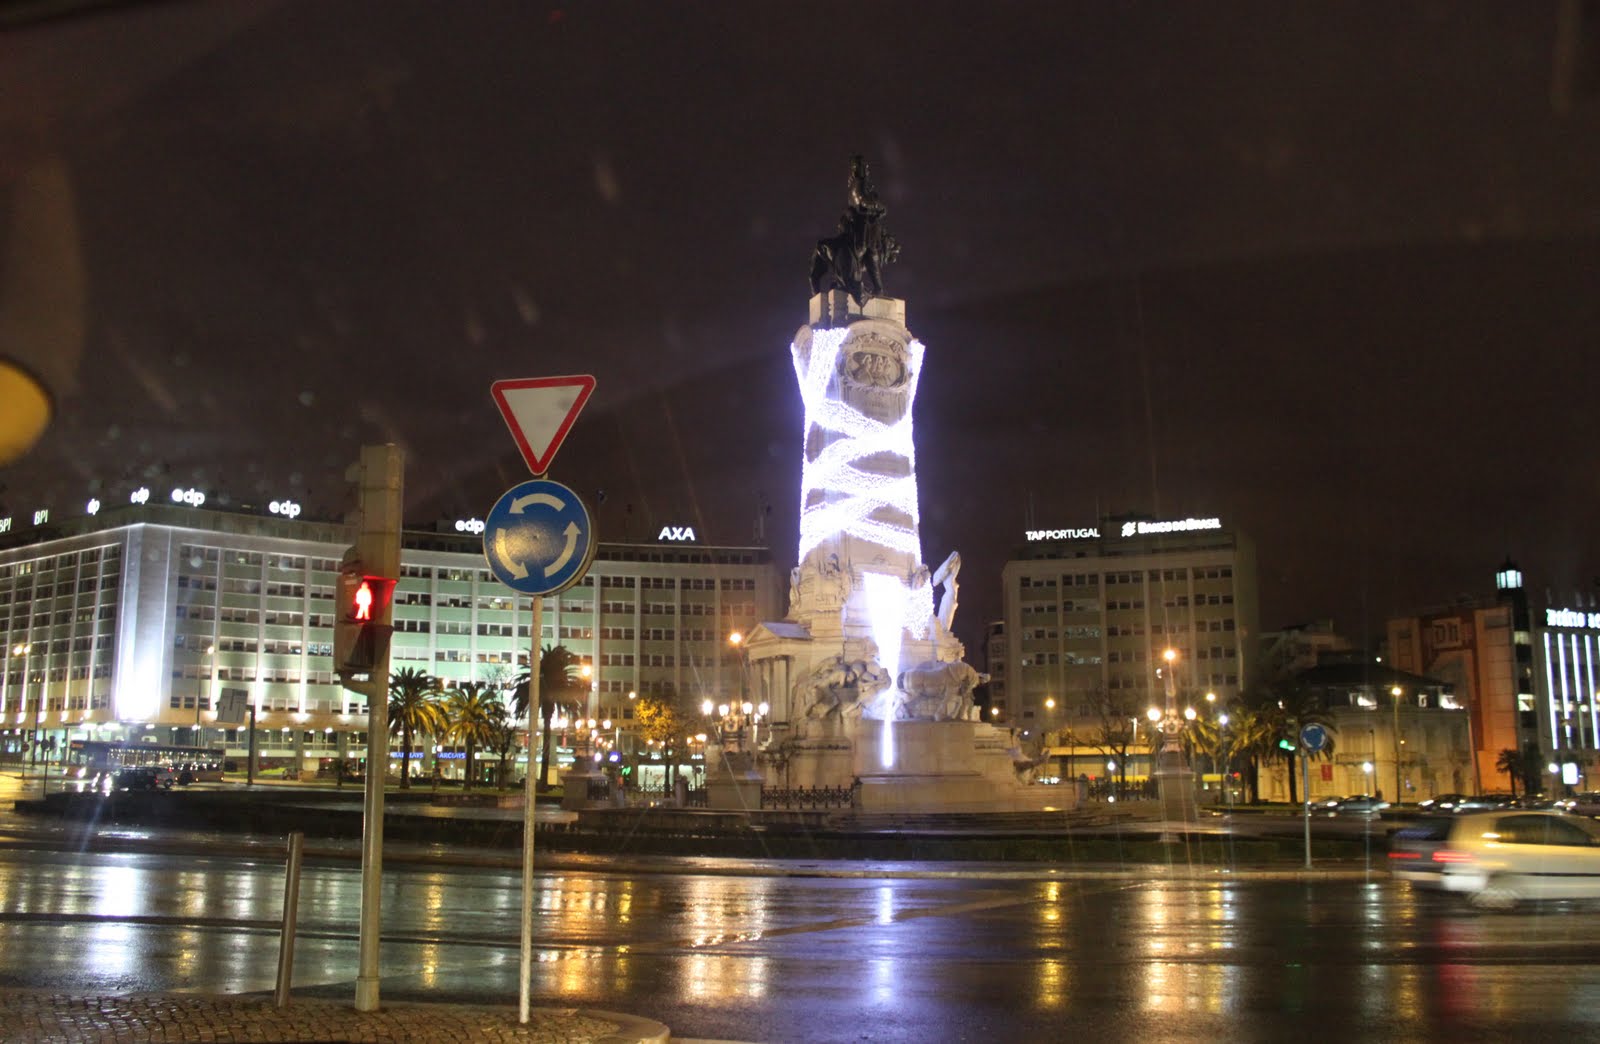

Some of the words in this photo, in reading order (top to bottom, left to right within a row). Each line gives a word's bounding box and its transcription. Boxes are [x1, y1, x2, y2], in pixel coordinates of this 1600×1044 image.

[130, 486, 149, 505] edp
[170, 487, 206, 508] edp
[268, 499, 301, 519] edp
[33, 509, 49, 526] BPI
[454, 518, 484, 534] edp
[658, 526, 696, 542] AXA
[1025, 529, 1045, 541] TAP
[1045, 527, 1101, 540] PORTUGAL
[391, 751, 425, 760] BALAYS
[438, 751, 467, 760] ARCLAYS
